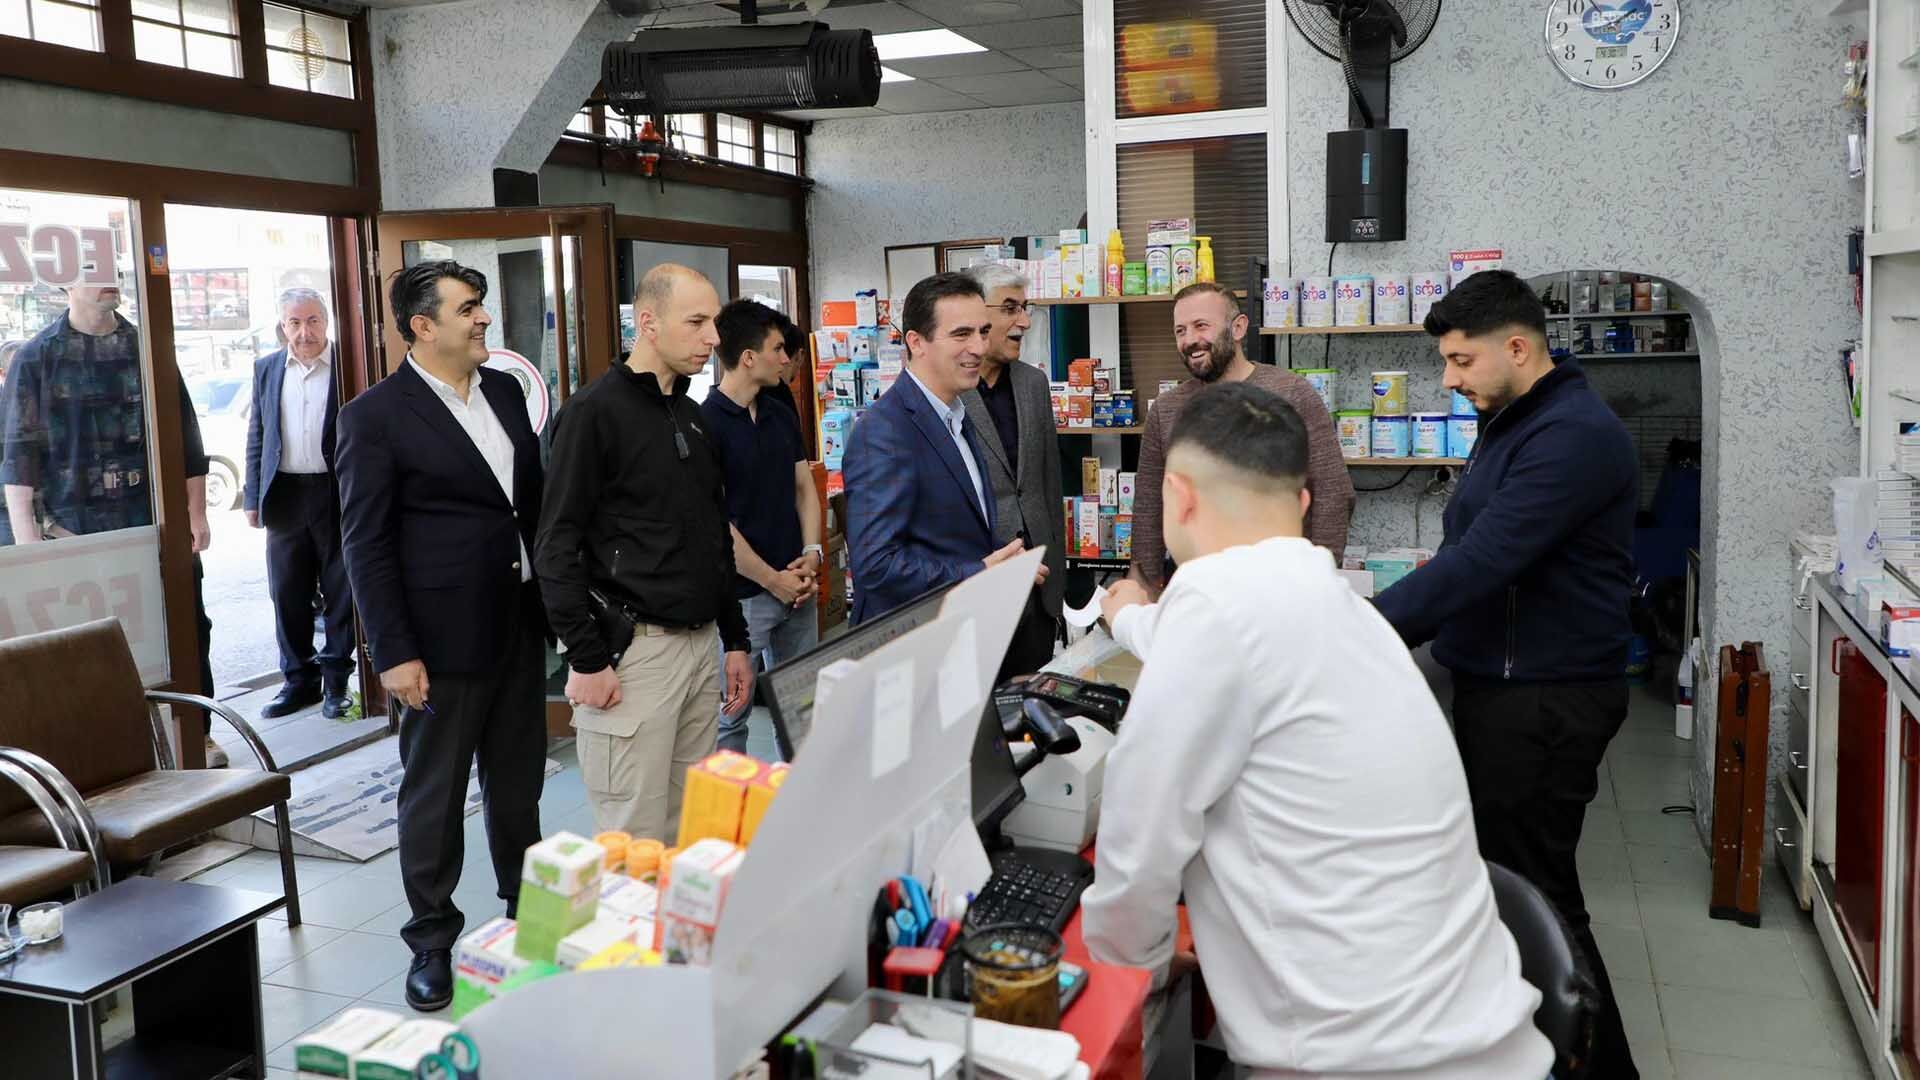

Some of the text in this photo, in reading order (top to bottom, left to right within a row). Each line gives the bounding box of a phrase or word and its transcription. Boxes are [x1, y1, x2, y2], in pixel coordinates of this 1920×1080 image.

[1567, 0, 1585, 15] 10
[1556, 22, 1568, 37] 9
[1659, 14, 1671, 30] 3
[1565, 44, 1576, 60] 8
[1650, 37, 1662, 52] 4
[1584, 59, 1593, 75] 7
[1632, 55, 1643, 72] 5
[1606, 64, 1616, 80] 6
[1265, 286, 1289, 301] sma
[1302, 286, 1327, 301] sma
[1337, 284, 1361, 299] sma
[1377, 281, 1404, 297] sma
[1415, 280, 1442, 296] sma
